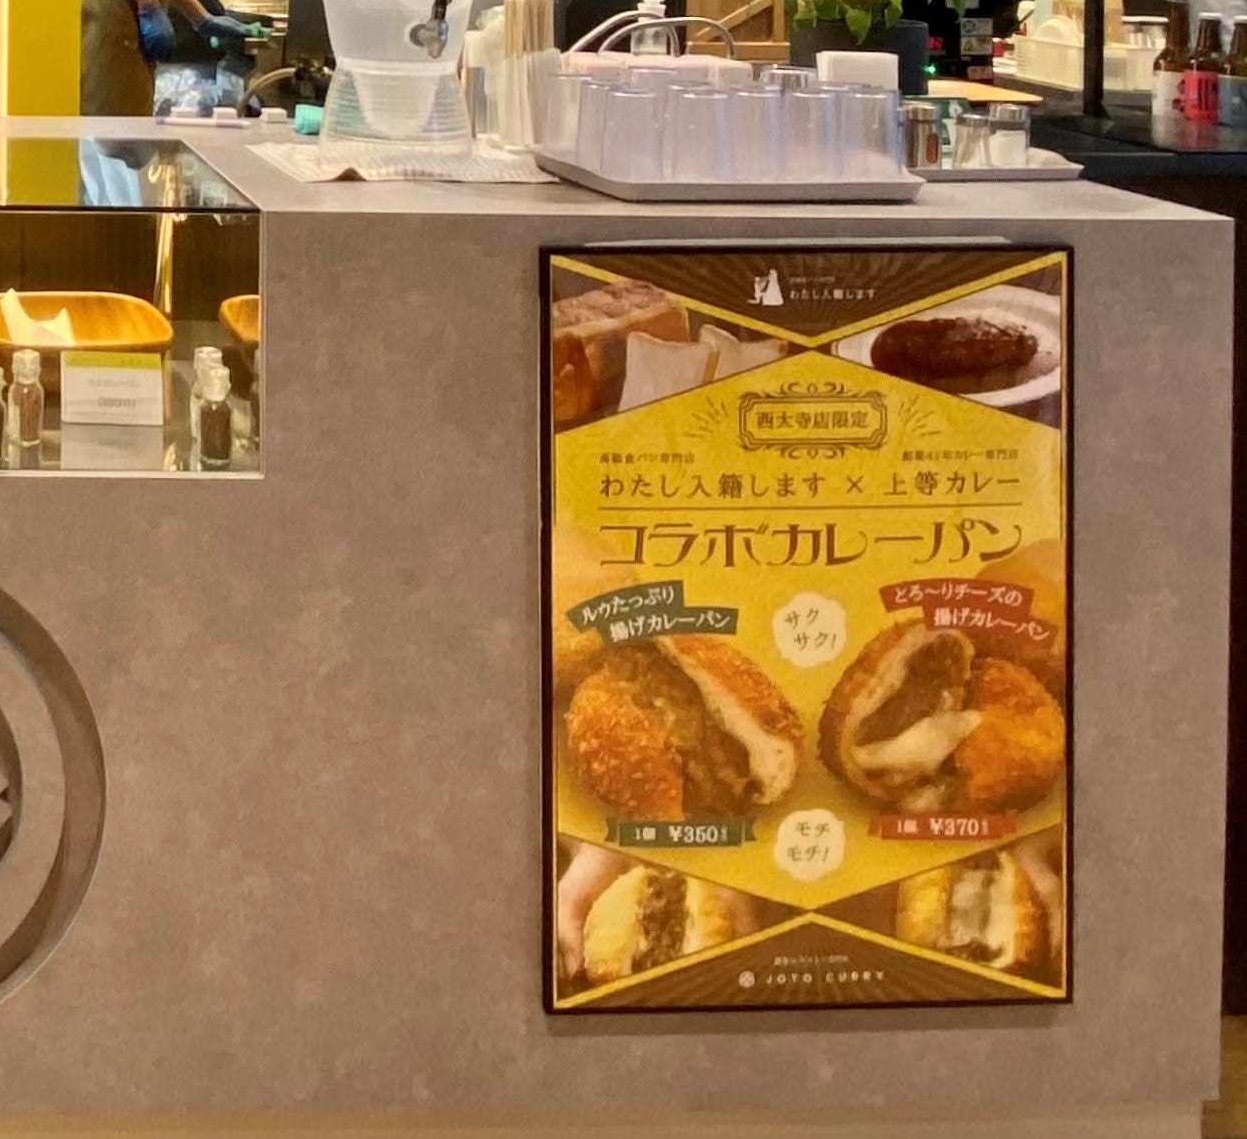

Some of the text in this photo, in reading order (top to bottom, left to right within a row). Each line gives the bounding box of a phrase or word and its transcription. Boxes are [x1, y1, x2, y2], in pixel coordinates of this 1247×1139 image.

[756, 410, 870, 431] 西大寺店限定
[599, 472, 826, 500] わたし入籍します
[883, 470, 1021, 497] 上等カレー
[599, 518, 1023, 568] コラボカレーパン
[609, 609, 731, 643] 揚げカレーパン
[784, 607, 820, 629] サク
[933, 606, 1051, 641] 揚げカレーパン
[795, 821, 831, 837] モチ
[928, 817, 980, 837] ¥370
